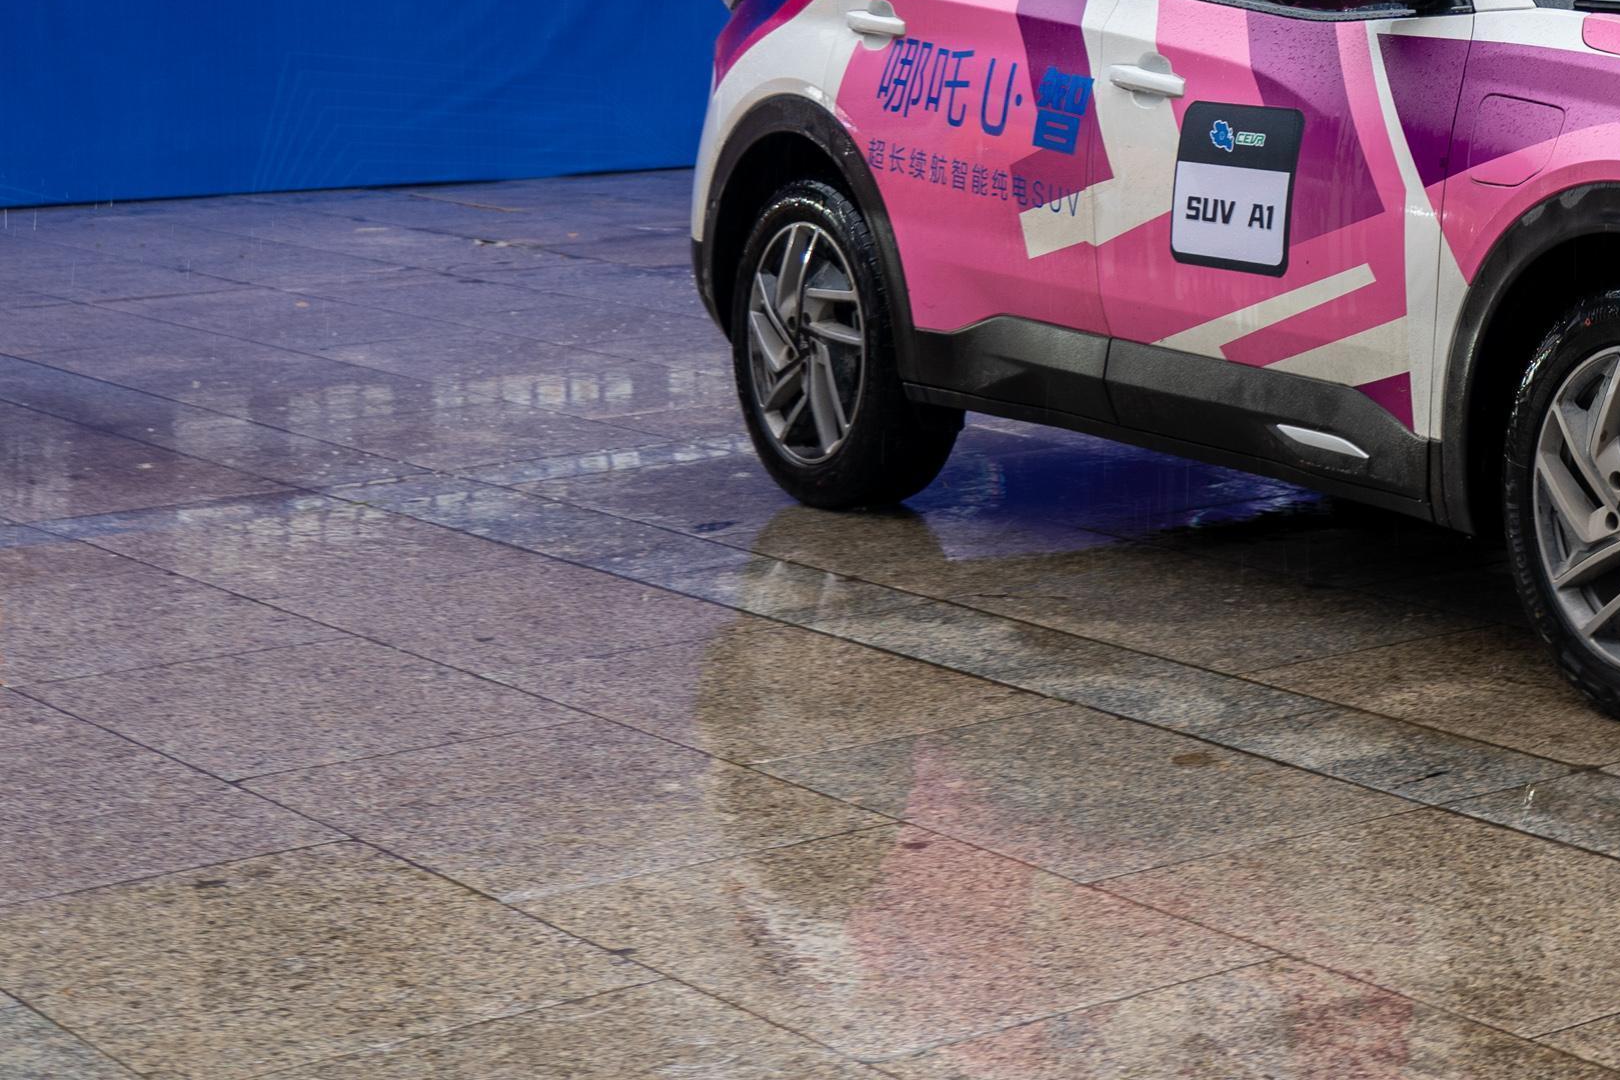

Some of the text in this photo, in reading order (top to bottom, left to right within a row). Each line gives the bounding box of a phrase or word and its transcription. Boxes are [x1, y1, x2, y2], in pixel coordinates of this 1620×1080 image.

[1235, 131, 1266, 147] CEVR
[1185, 195, 1274, 230] SUV A1
